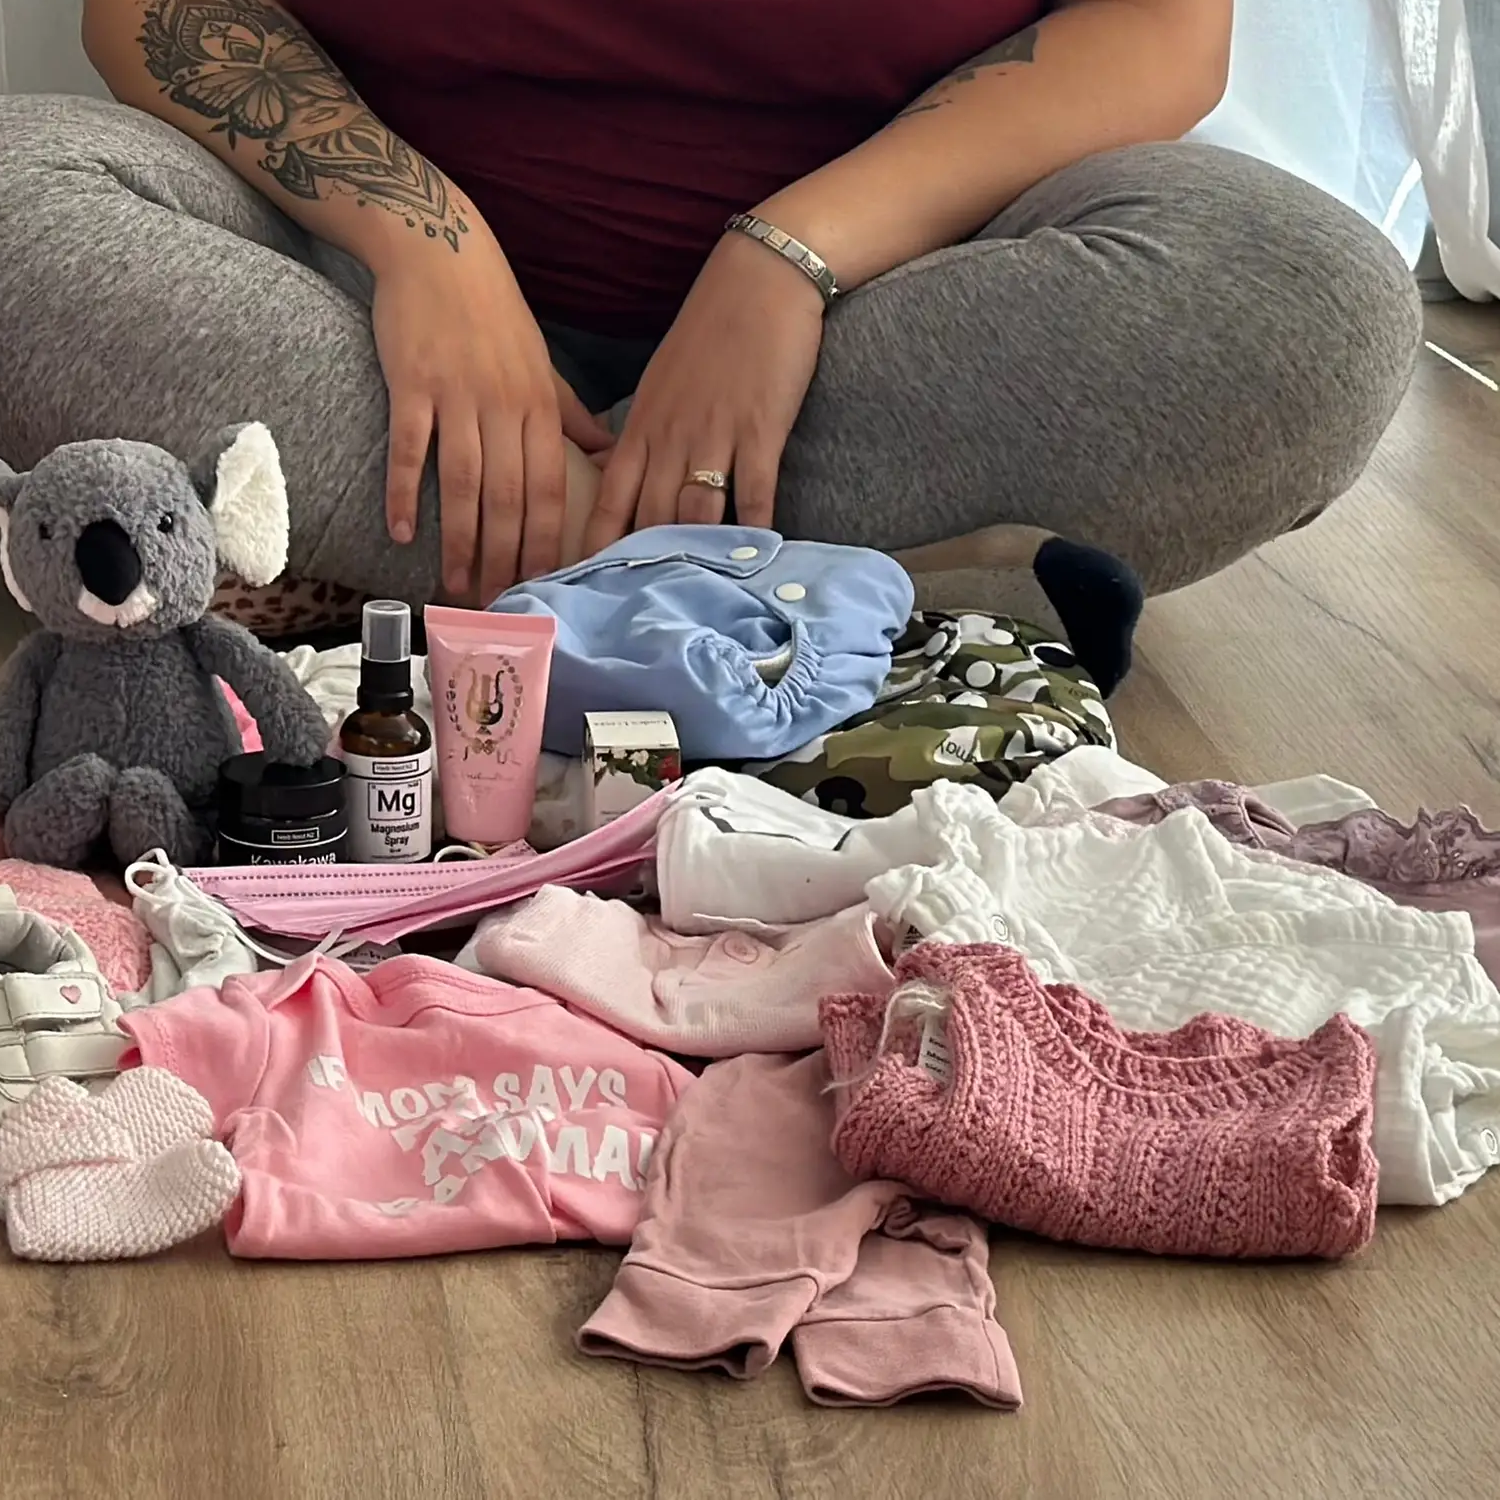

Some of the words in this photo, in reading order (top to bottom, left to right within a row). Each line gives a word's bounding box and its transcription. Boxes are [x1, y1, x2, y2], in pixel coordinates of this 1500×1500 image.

[377, 788, 415, 816] Mg
[371, 822, 420, 836] Magnesium
[384, 835, 409, 847] Spray
[493, 1064, 627, 1121] SAYS
